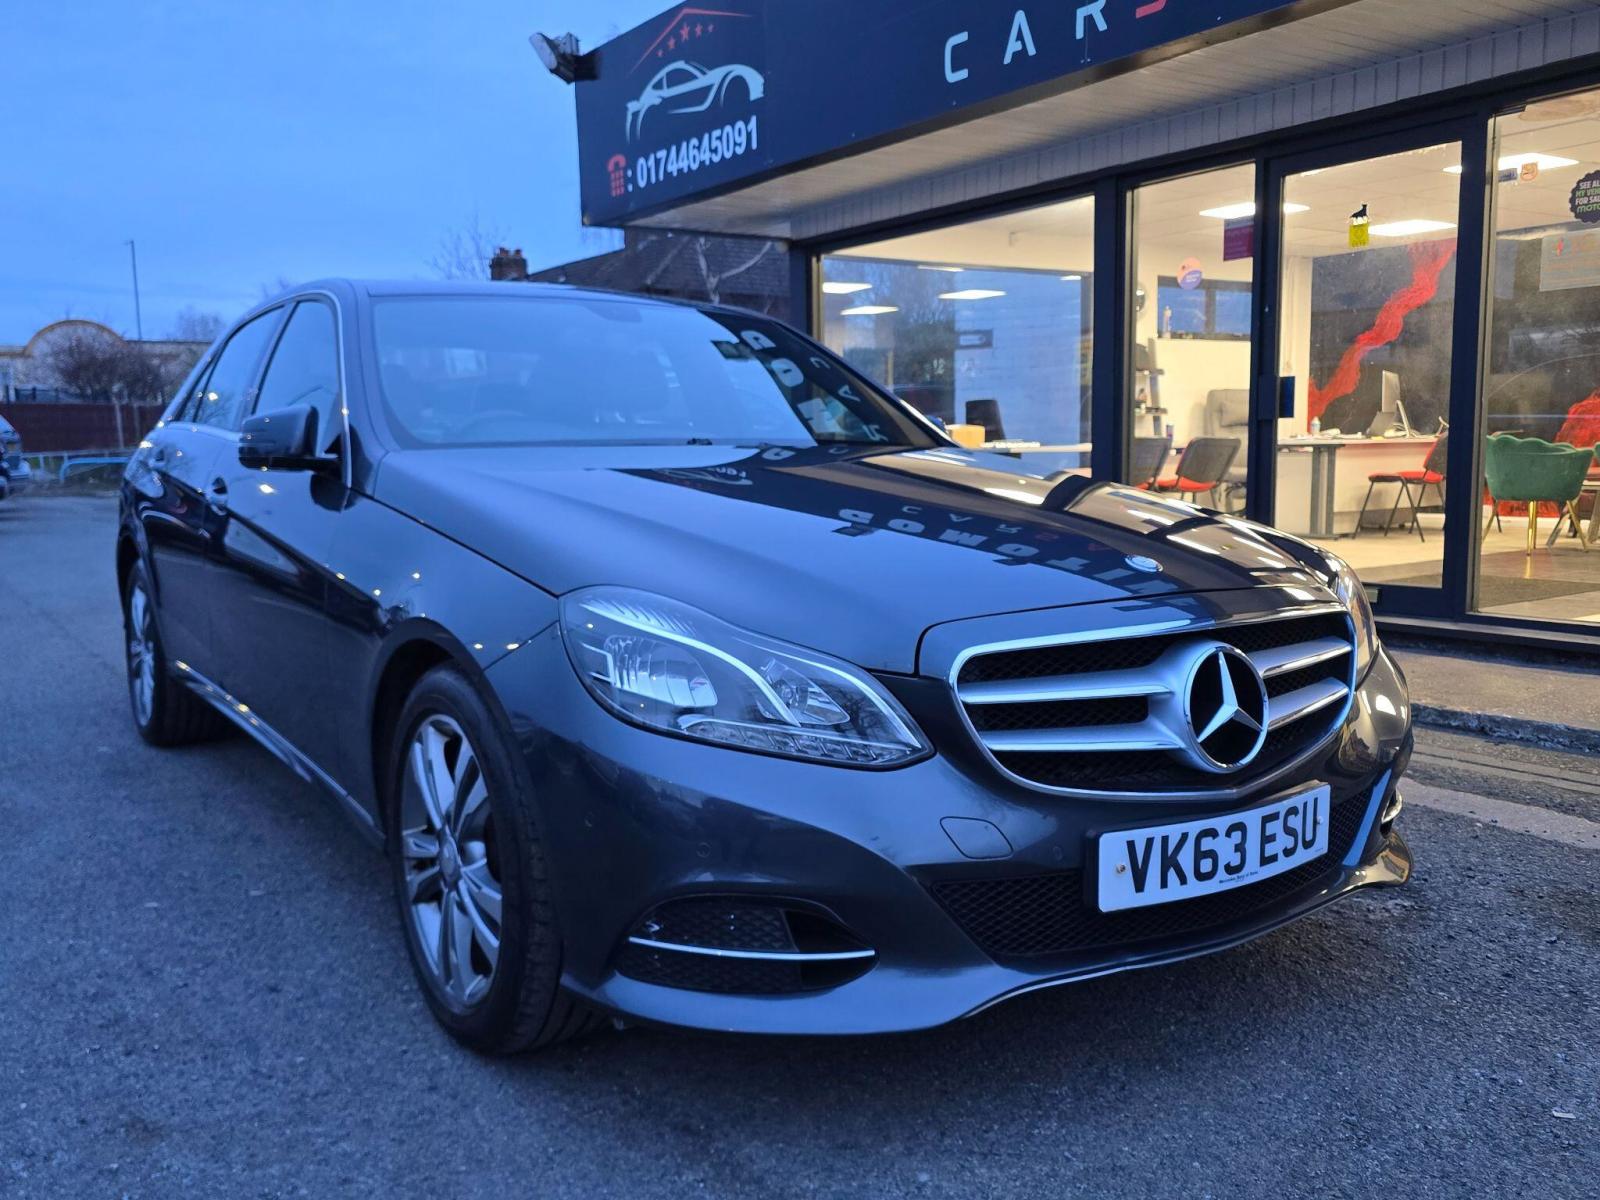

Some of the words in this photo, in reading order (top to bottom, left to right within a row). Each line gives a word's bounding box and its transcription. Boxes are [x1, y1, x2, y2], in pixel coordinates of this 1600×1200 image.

[637, 115, 757, 188] 01744645091
[1575, 196, 1588, 205] FOR
[1126, 821, 1248, 893] VK63
[1259, 797, 1319, 867] ESU
